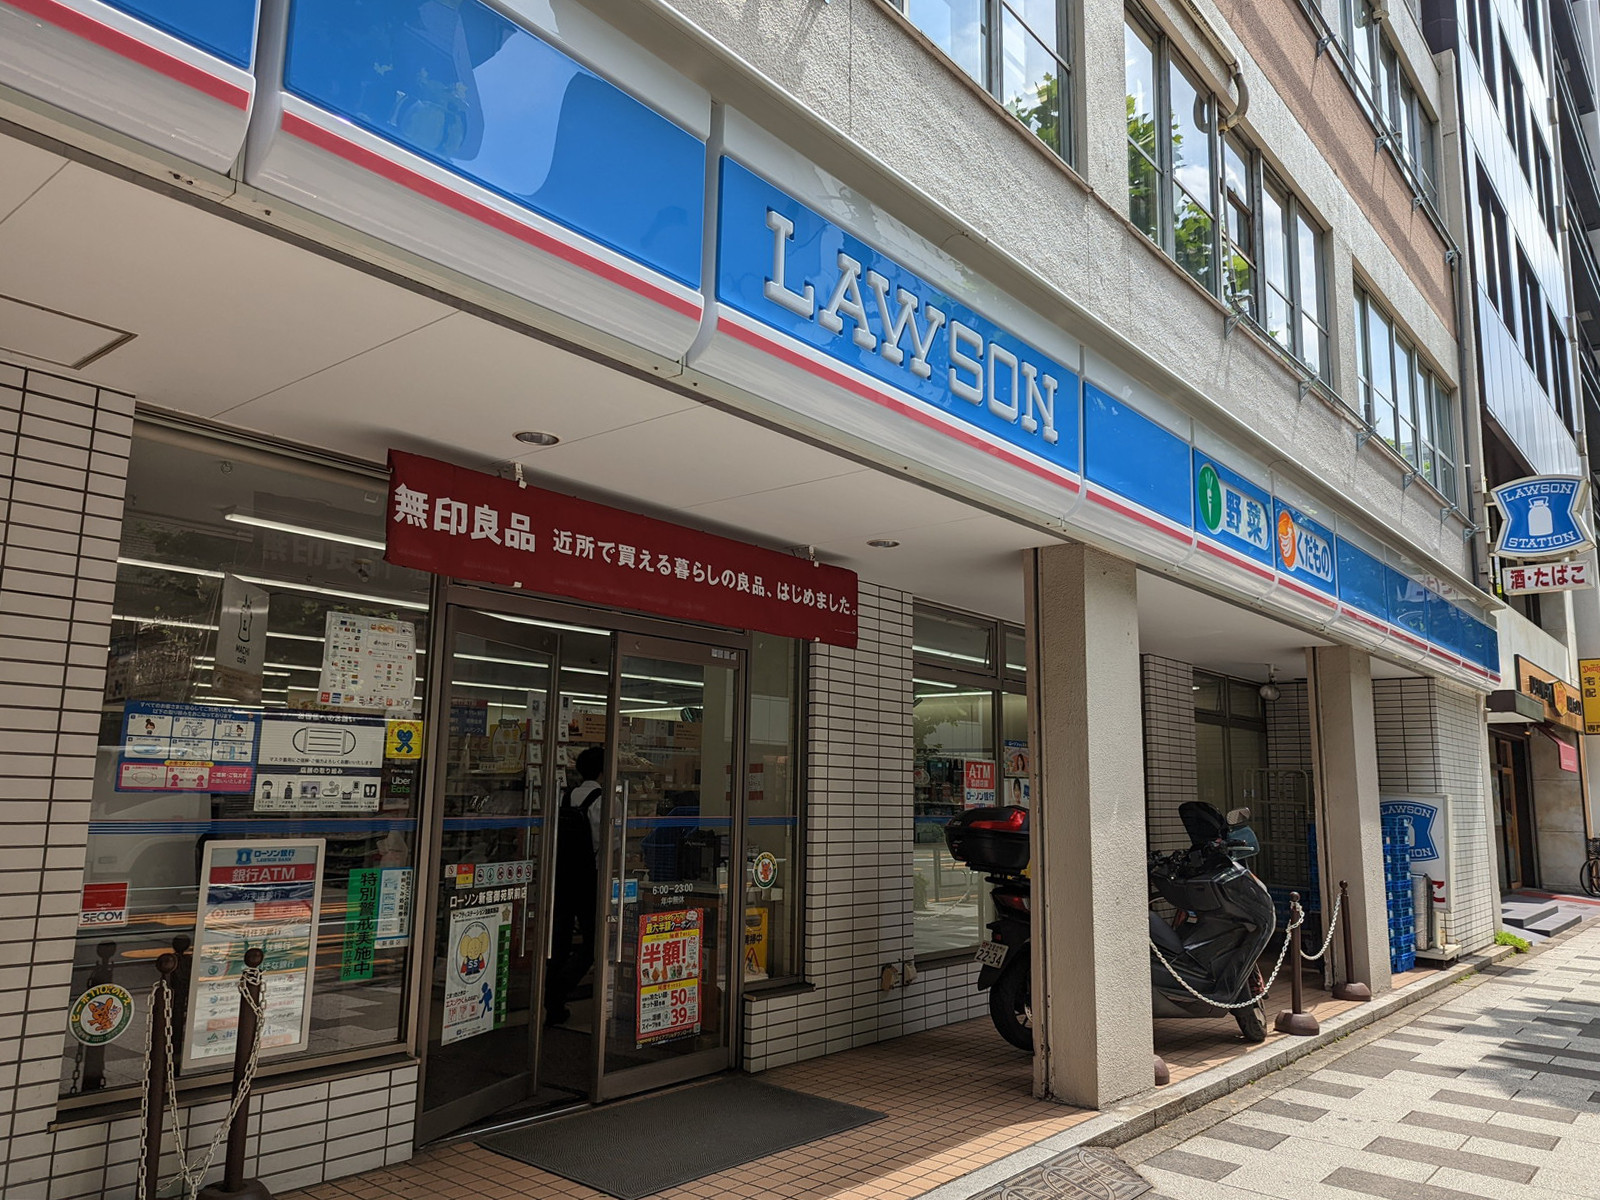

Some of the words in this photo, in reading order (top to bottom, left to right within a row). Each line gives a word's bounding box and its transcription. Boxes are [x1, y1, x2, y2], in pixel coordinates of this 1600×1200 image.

[764, 206, 1058, 445] LAWSON
[1503, 483, 1572, 502] LAWSON
[1226, 489, 1263, 545] 野菜
[1508, 531, 1576, 548] STATION
[393, 483, 536, 552] 無印良品
[552, 528, 857, 617] 近所で買える暮らしの良品、はじめました。
[1297, 531, 1330, 577] くだもの
[1510, 565, 1585, 589] 酒・たばこ
[391, 776, 411, 785] Uber
[968, 764, 991, 779] ATM
[391, 784, 410, 793] Eats
[966, 791, 994, 801] ローソン銀行
[254, 848, 296, 858] ローソン銀行
[232, 867, 296, 882] 銀行ATM
[450, 886, 528, 908] ローソン新宿御苑駅前店
[661, 896, 685, 905] 年中無休
[82, 911, 122, 923] SECOM
[353, 872, 378, 976] 特別警戒実施中
[642, 939, 686, 969] 半額!
[467, 960, 478, 969] SS
[670, 988, 687, 1006] 50
[670, 1008, 687, 1026] 39
